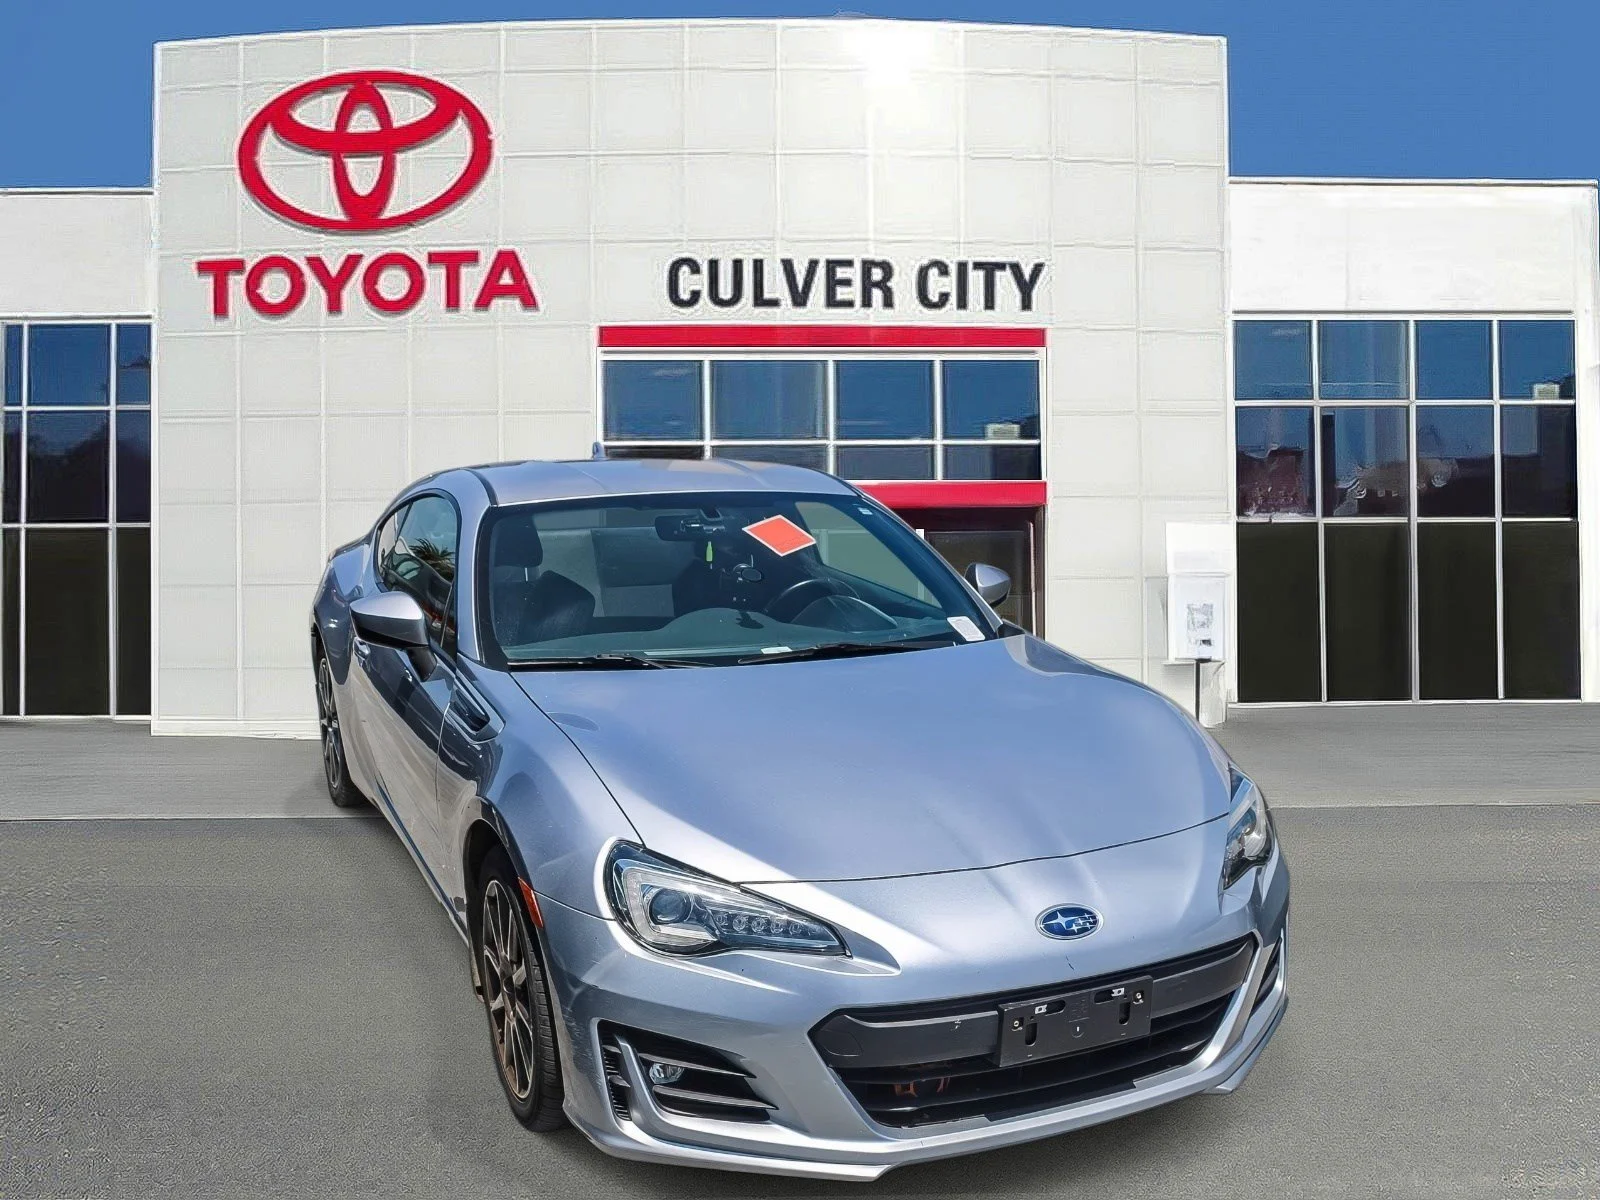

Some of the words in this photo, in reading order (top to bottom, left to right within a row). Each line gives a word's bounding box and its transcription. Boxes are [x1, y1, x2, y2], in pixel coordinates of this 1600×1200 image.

[196, 249, 538, 317] TOYOTA
[668, 257, 894, 309] CULVER
[917, 260, 1045, 312] CITY
